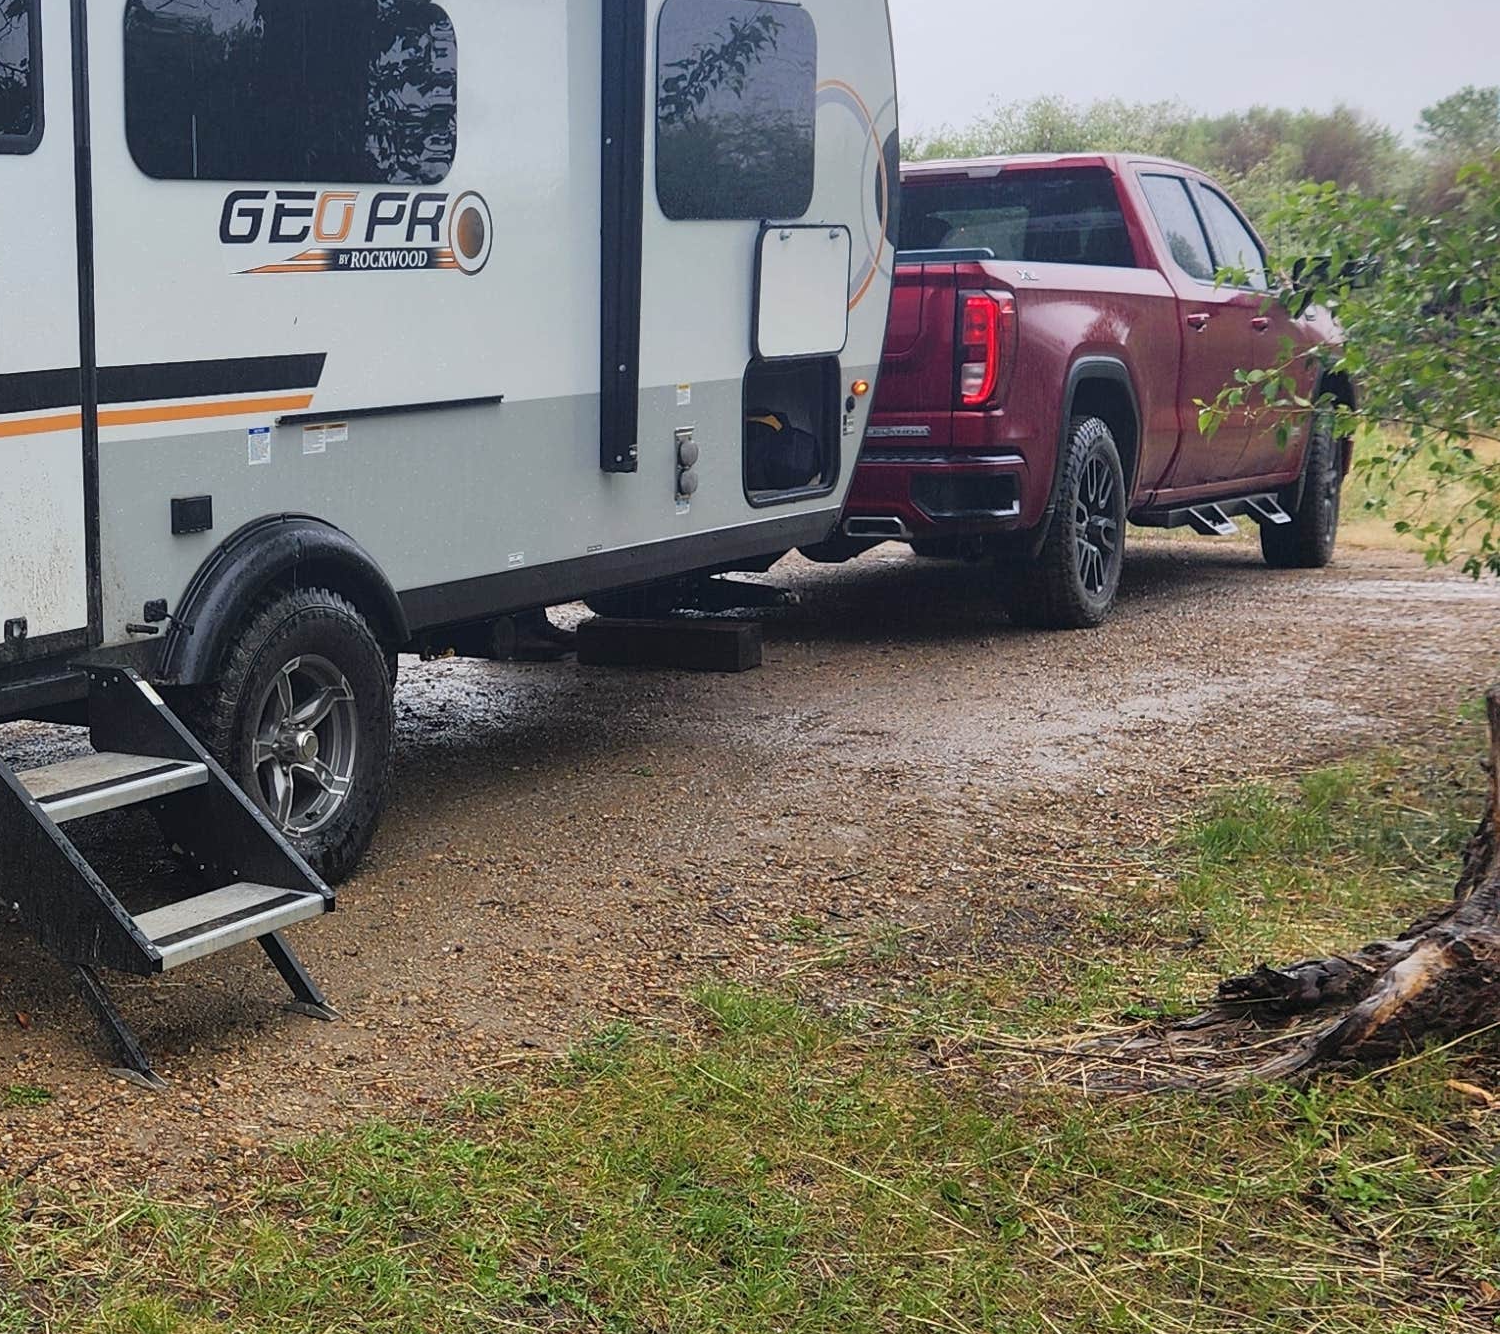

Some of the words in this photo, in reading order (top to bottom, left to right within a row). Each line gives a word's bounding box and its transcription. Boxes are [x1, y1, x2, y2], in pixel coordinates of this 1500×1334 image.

[219, 190, 360, 244] GEO
[338, 254, 349, 266] BY
[350, 250, 428, 269] ROCKWOOD
